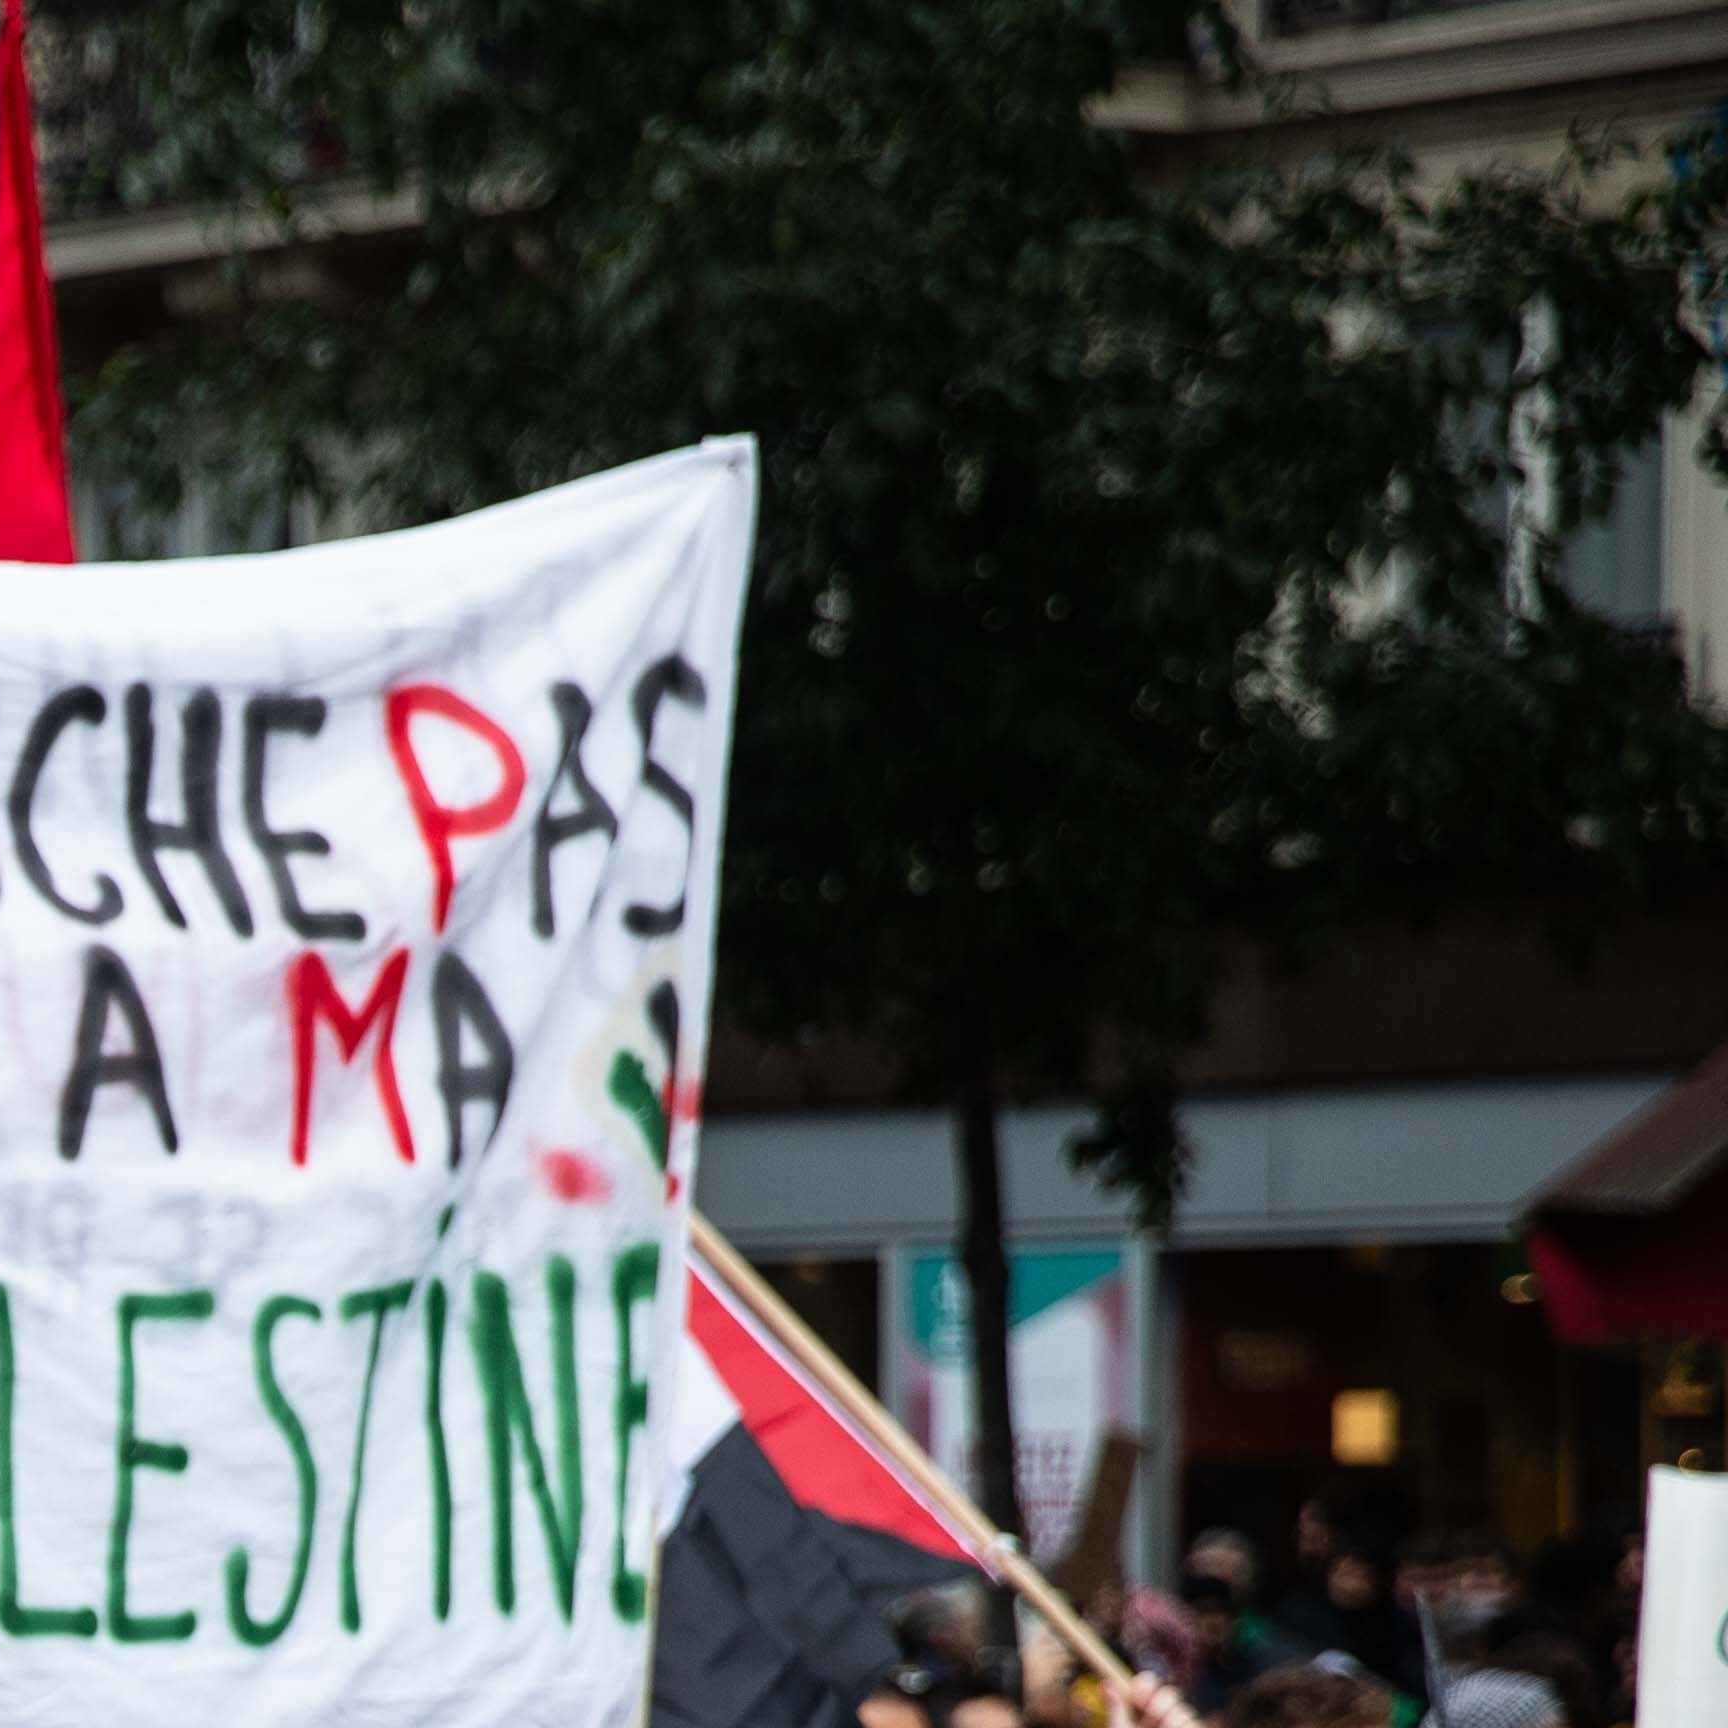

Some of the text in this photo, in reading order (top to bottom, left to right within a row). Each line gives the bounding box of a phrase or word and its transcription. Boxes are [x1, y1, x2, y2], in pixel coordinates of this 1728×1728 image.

[384, 653, 708, 939] PAS
[60, 946, 515, 1171] A MA
